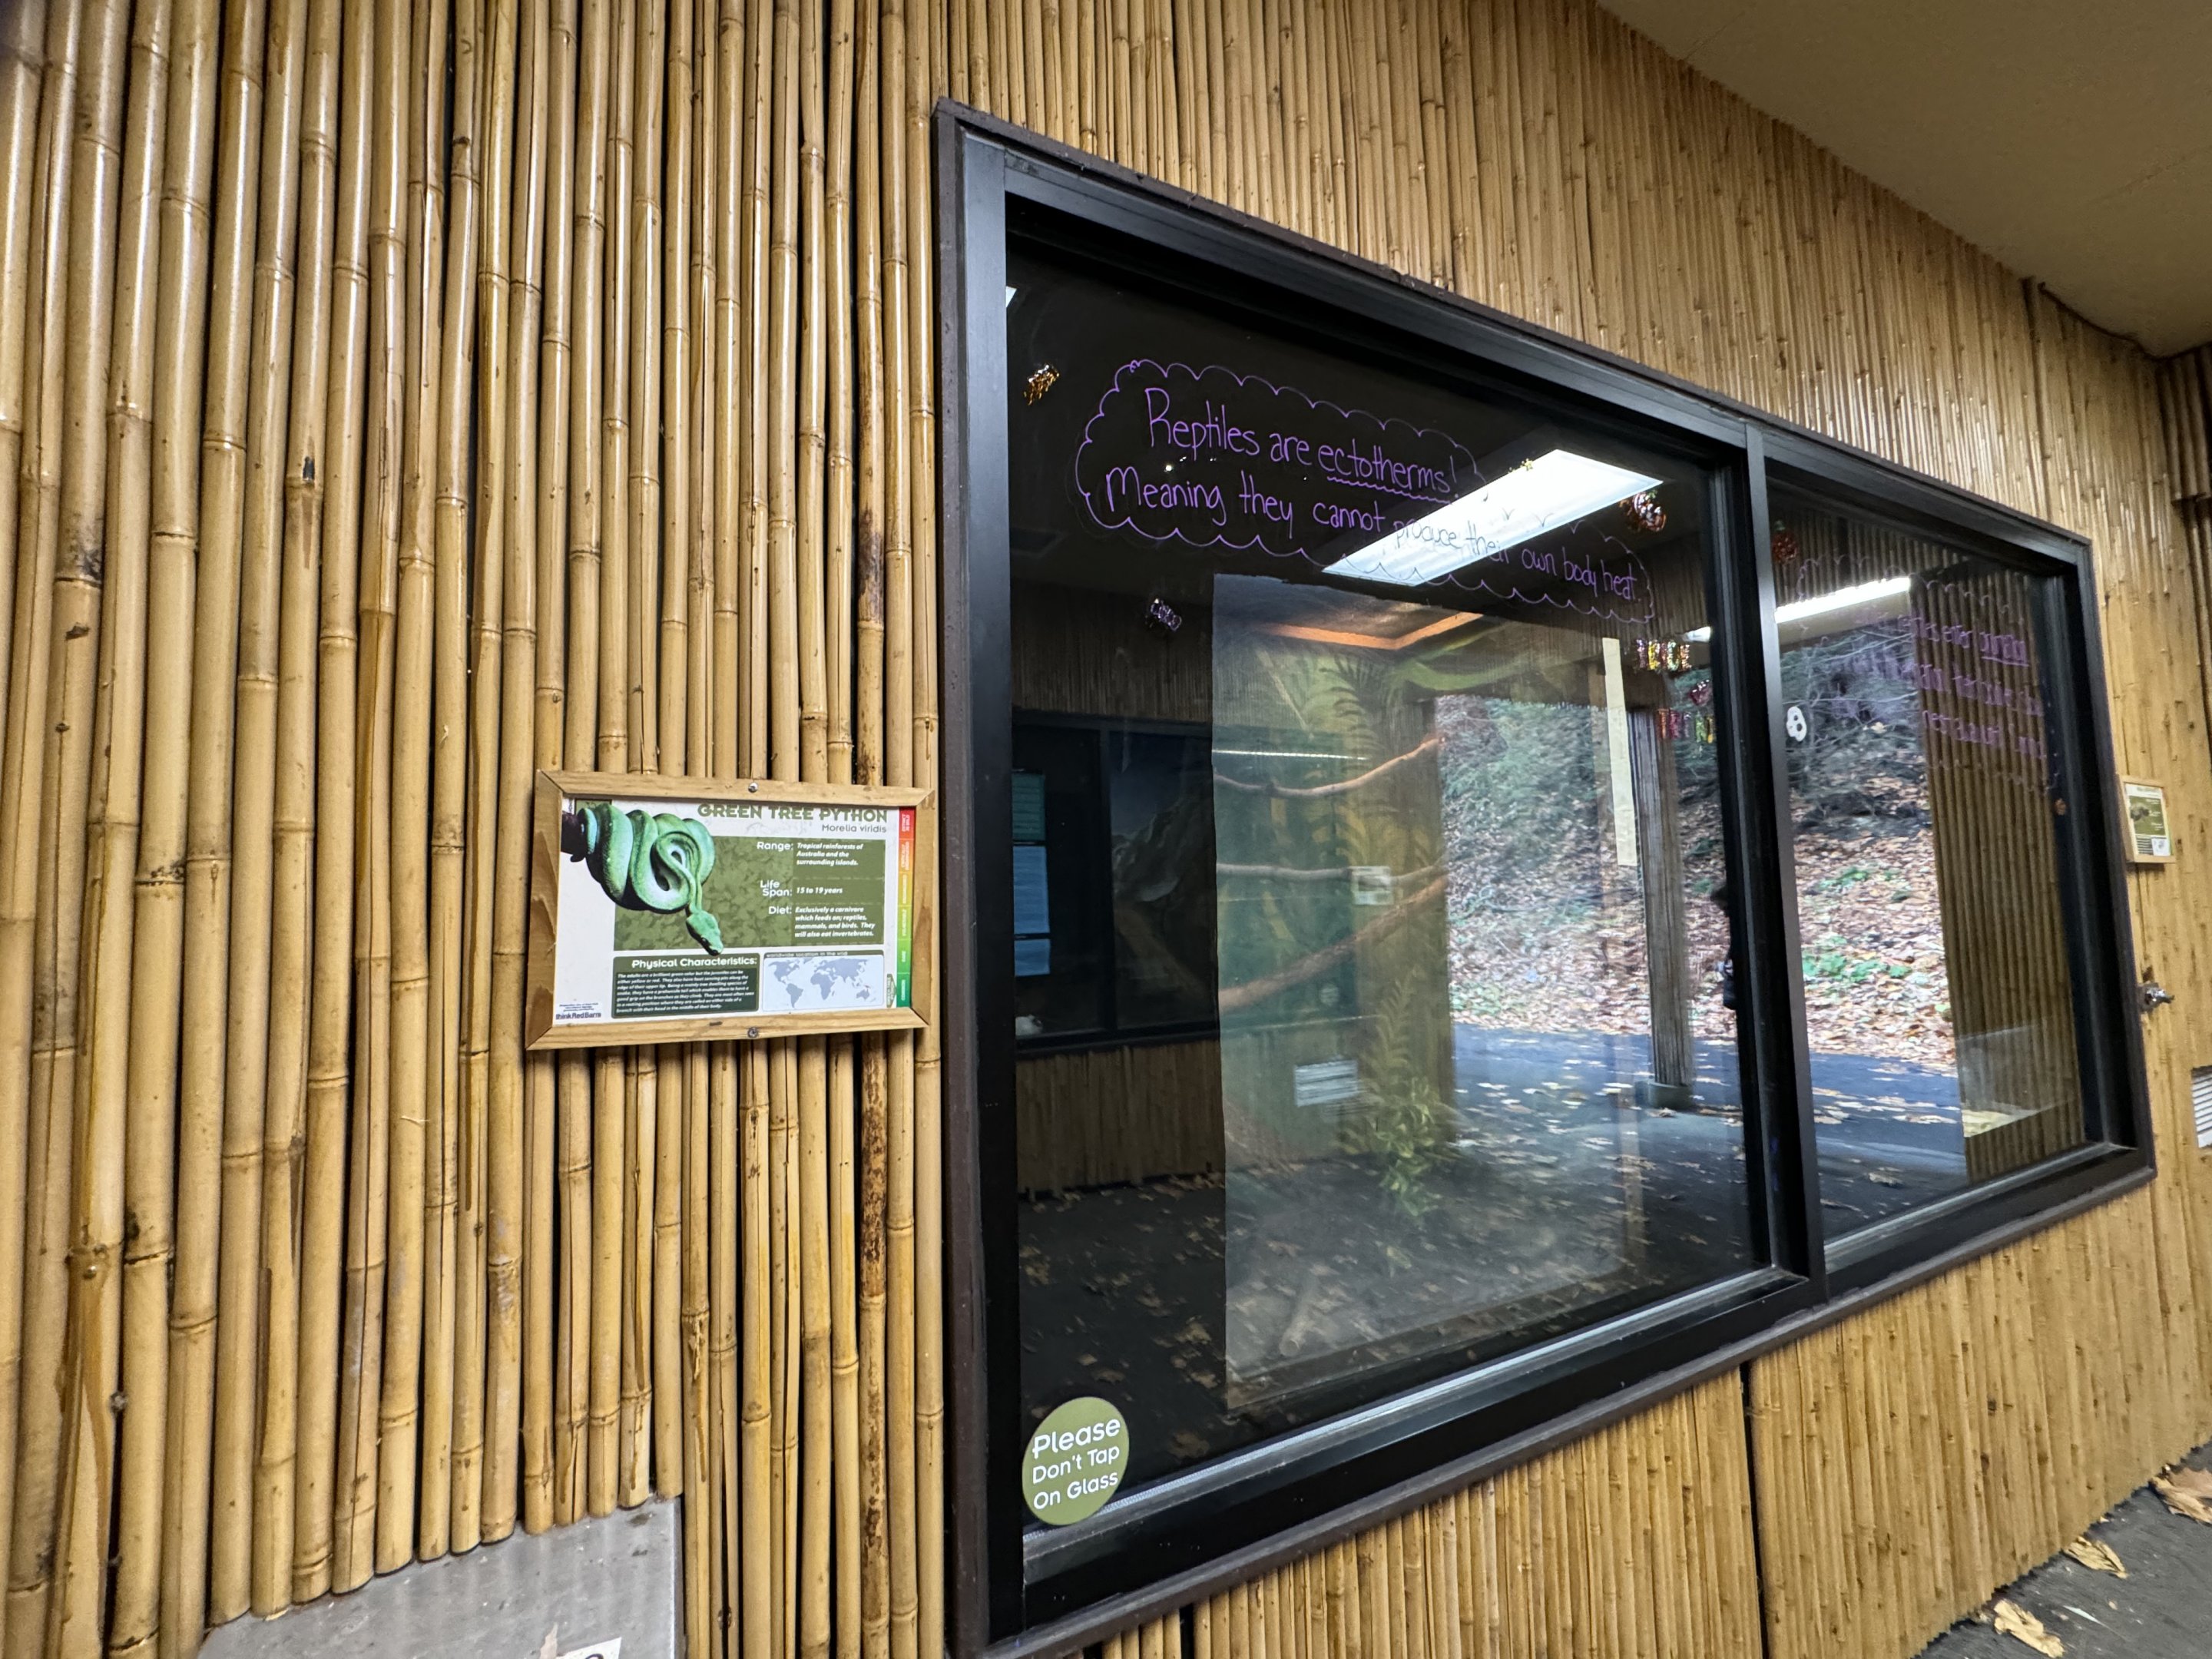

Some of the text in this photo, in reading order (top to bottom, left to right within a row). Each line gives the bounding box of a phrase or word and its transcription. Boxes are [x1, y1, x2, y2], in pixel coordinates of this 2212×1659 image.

[1144, 387, 1459, 499] Reptiles are ectotherms!
[1106, 466, 1227, 526] Meaning
[1239, 470, 1293, 539] they
[1313, 500, 1386, 532] cannot
[1392, 518, 1461, 548] produce
[1466, 520, 1509, 565] their
[1522, 548, 1557, 576] own
[1562, 546, 1598, 598] body
[697, 803, 887, 823] GREEN TREE PYTHON
[822, 824, 886, 833] Morelia viridis
[757, 841, 793, 852] Range:
[760, 879, 780, 889] Life
[762, 889, 793, 897] Span:
[824, 887, 843, 896] years
[768, 906, 792, 915] Diet:
[860, 922, 876, 930] They
[631, 956, 757, 970] Physical Characteristics:
[1031, 1419, 1121, 1459] Please
[1032, 1445, 1120, 1485] Don't Tap
[1033, 1472, 1118, 1510] On Glass
